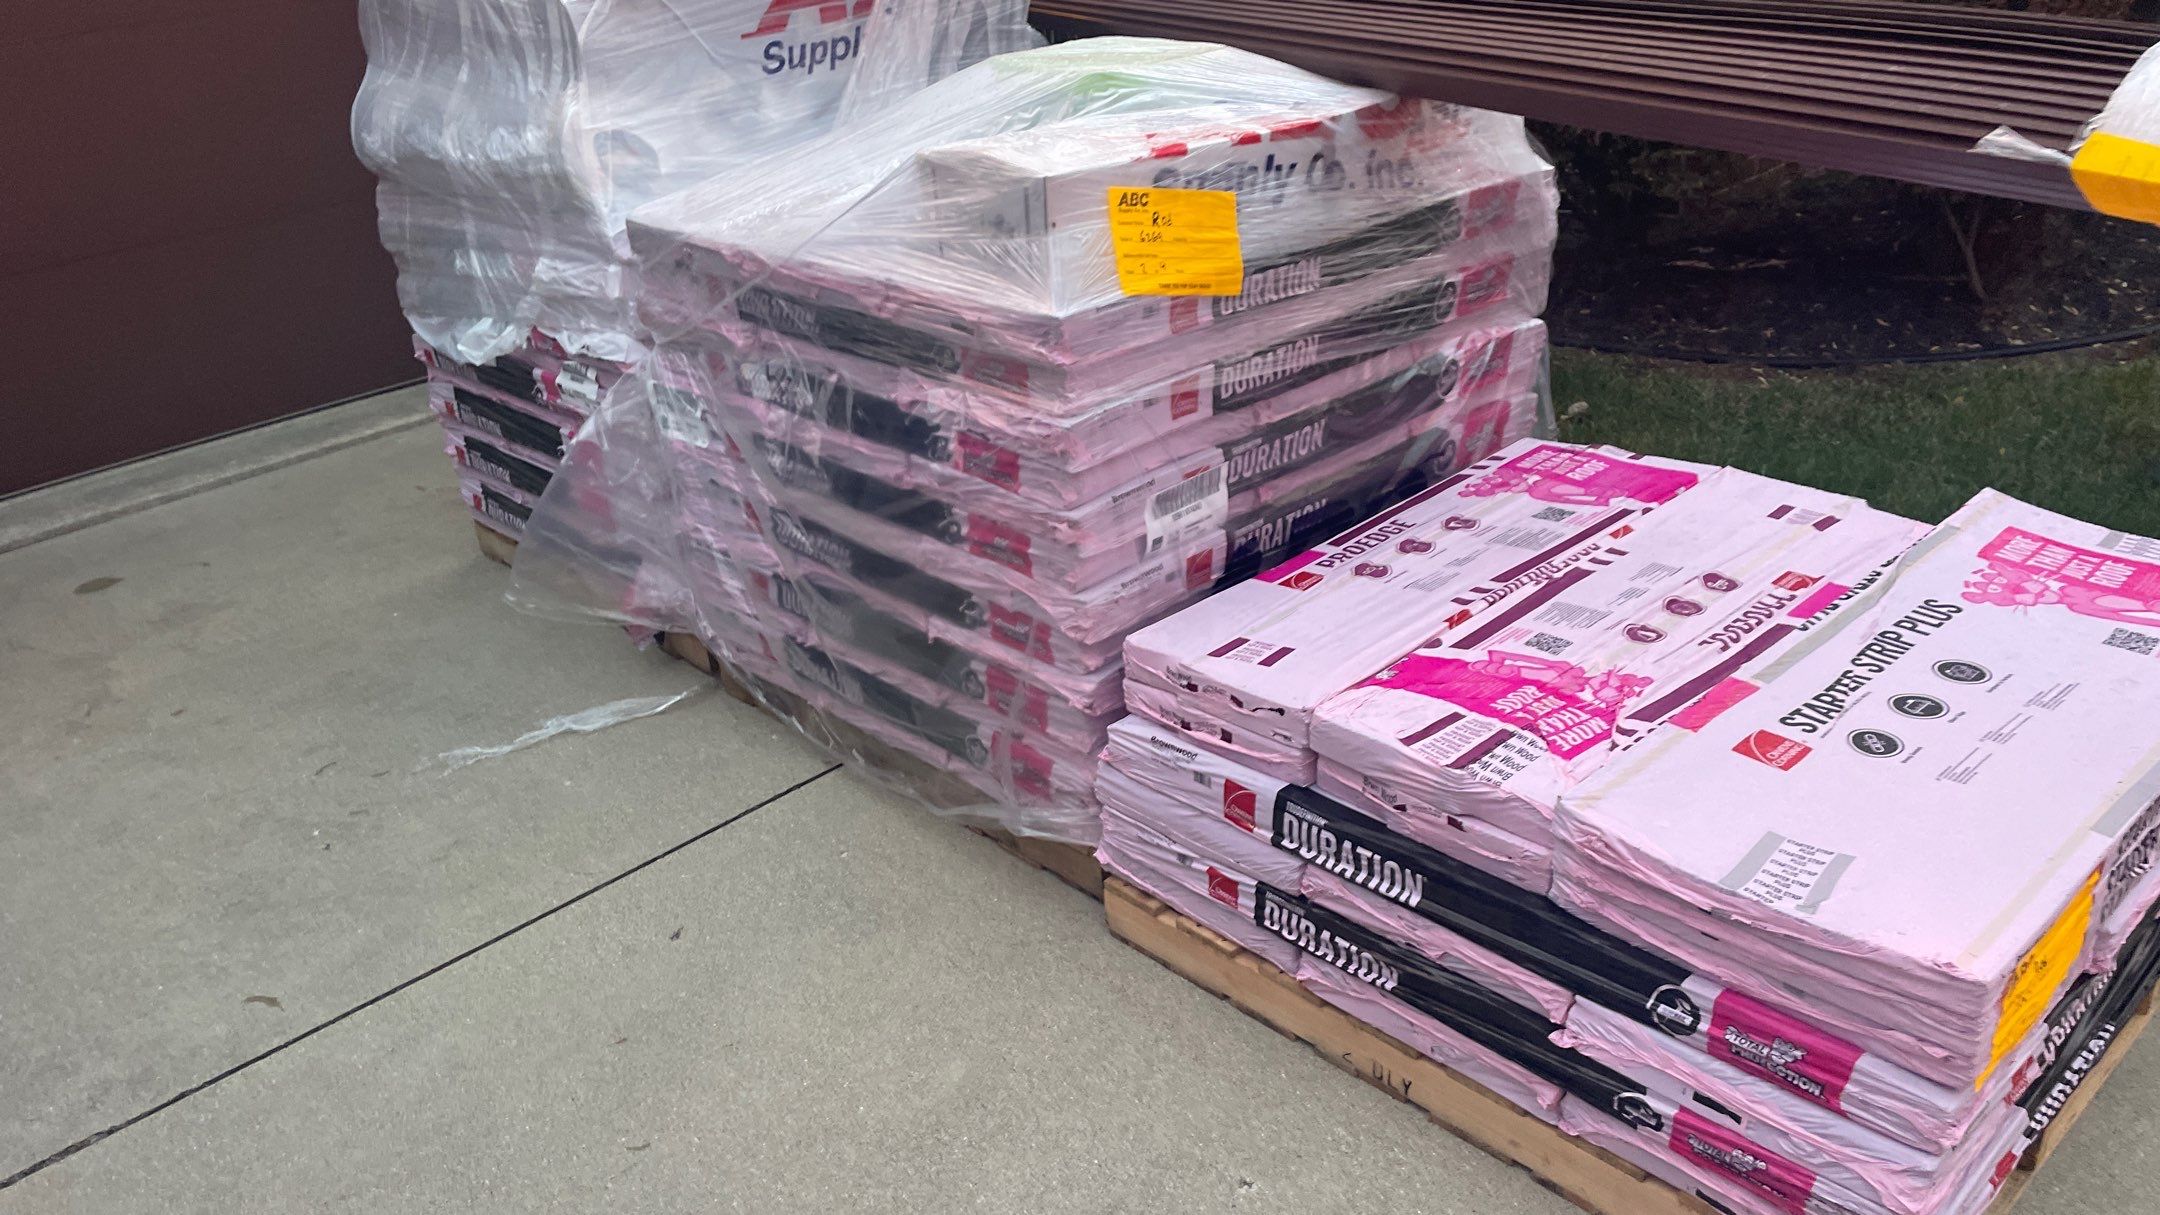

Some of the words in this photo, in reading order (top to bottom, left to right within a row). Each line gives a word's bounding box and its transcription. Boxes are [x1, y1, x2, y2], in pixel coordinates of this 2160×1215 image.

[762, 25, 861, 75] Suppl
[1118, 191, 1149, 207] ABC
[1220, 256, 1321, 315] DURATION
[1220, 335, 1320, 399] DURATION
[1229, 418, 1328, 484] DURATION
[1315, 519, 1417, 569] PROEDGE
[1994, 535, 2044, 563] MORE
[2024, 544, 2077, 571] THAN
[2086, 560, 2137, 589] ROOF
[1778, 669, 1873, 734] STARTER
[1851, 630, 1915, 673] STRIP
[1893, 598, 1963, 636] PLUS
[1489, 685, 1546, 714] ROOF
[1535, 706, 1592, 736] THAN
[1546, 716, 1611, 751] MORE
[1280, 811, 1423, 908] DURATION
[1263, 900, 1400, 992] DURATION
[1732, 1033, 1769, 1056] TOTAL
